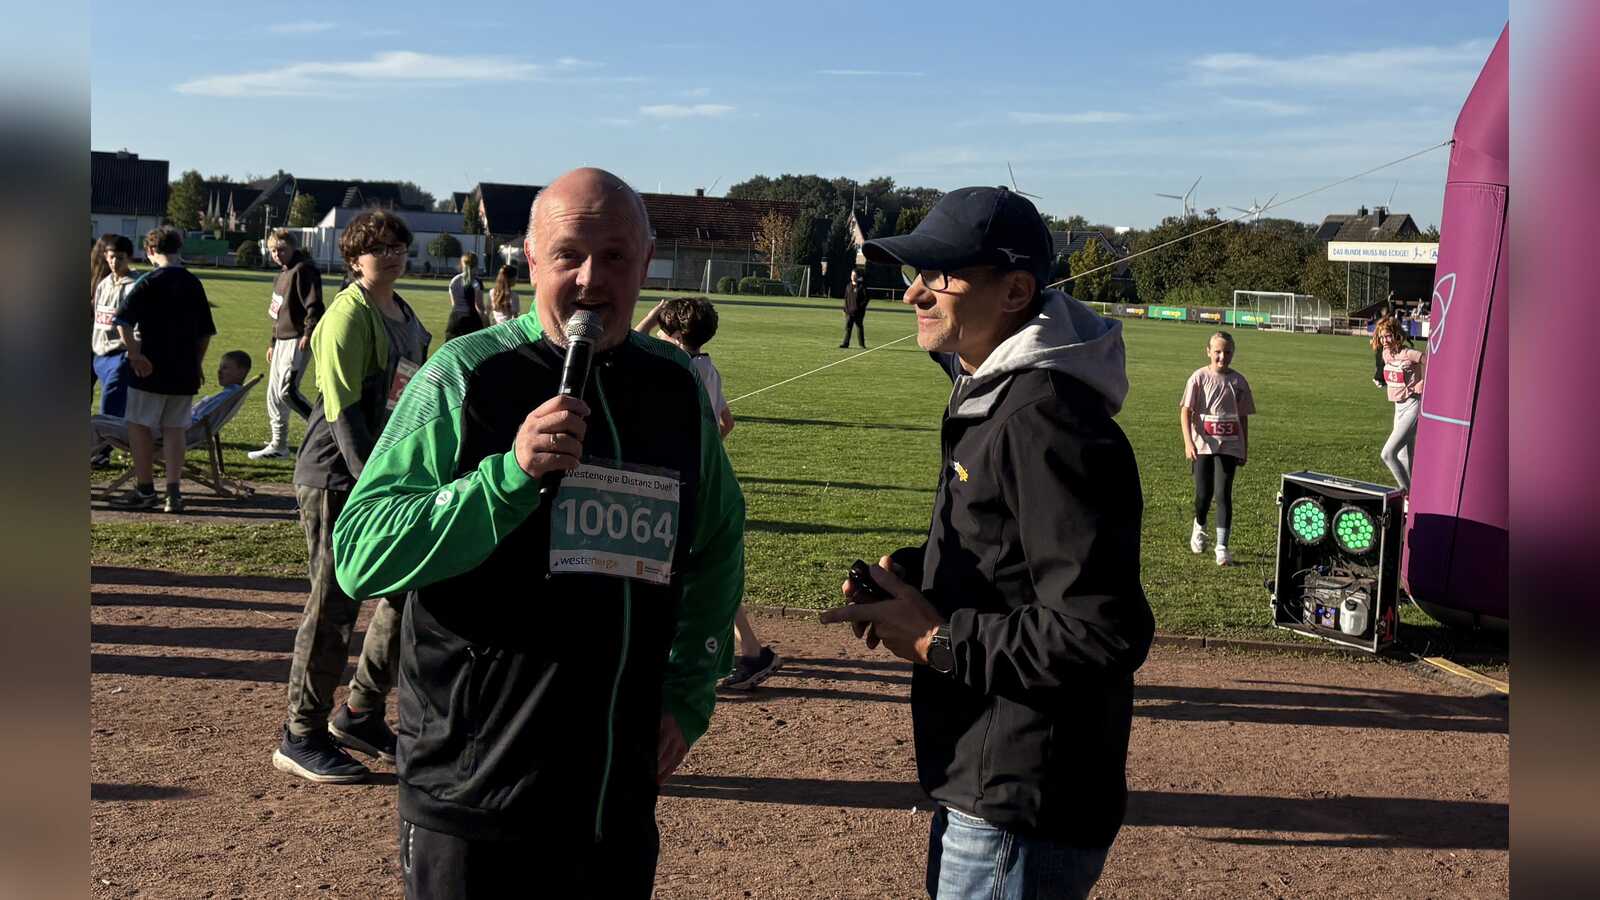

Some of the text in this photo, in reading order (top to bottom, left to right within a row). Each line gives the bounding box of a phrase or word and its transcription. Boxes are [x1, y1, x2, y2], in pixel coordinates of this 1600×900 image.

[1210, 422, 1233, 435] 153
[566, 468, 620, 484] Westenergie
[621, 476, 652, 488] Distanz
[558, 498, 675, 549] 10064
